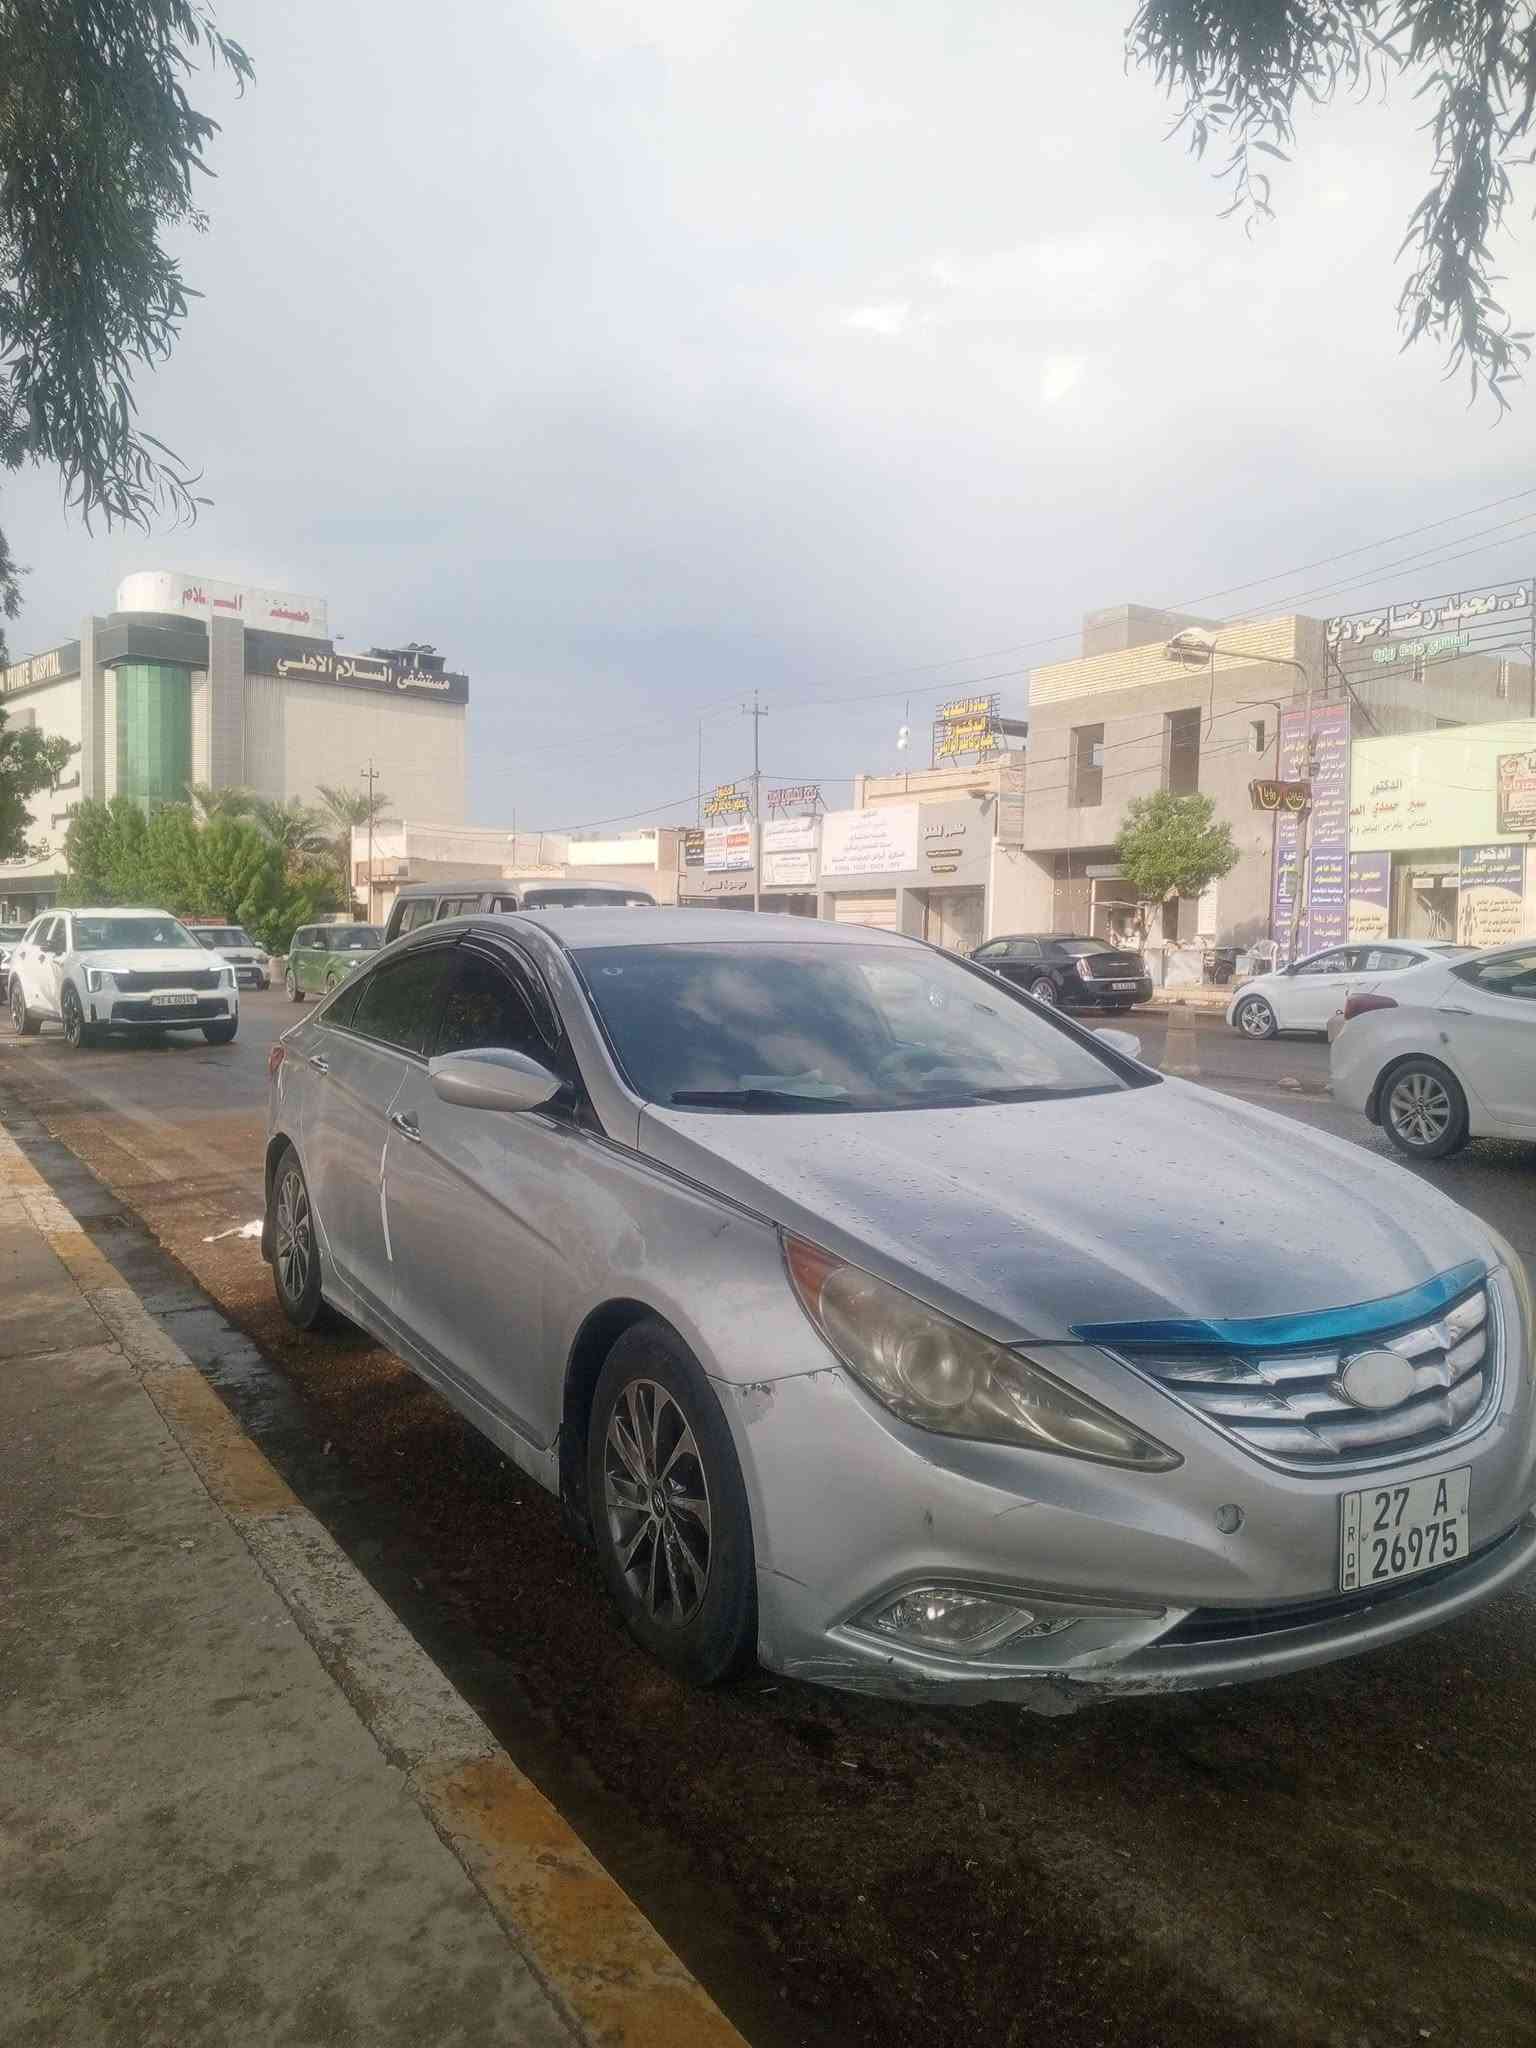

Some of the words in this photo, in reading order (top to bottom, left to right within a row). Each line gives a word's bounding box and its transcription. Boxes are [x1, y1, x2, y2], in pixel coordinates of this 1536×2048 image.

[1388, 600, 1439, 630] رضا
[1440, 594, 1499, 622] محمد
[1326, 615, 1386, 648] جودي
[335, 658, 393, 683] السلام
[396, 670, 451, 690] مستشفى
[1472, 847, 1512, 864] الدكتور
[1373, 1487, 1410, 1532] 27
[1433, 1478, 1448, 1516] A
[1372, 1518, 1457, 1579] 26975
